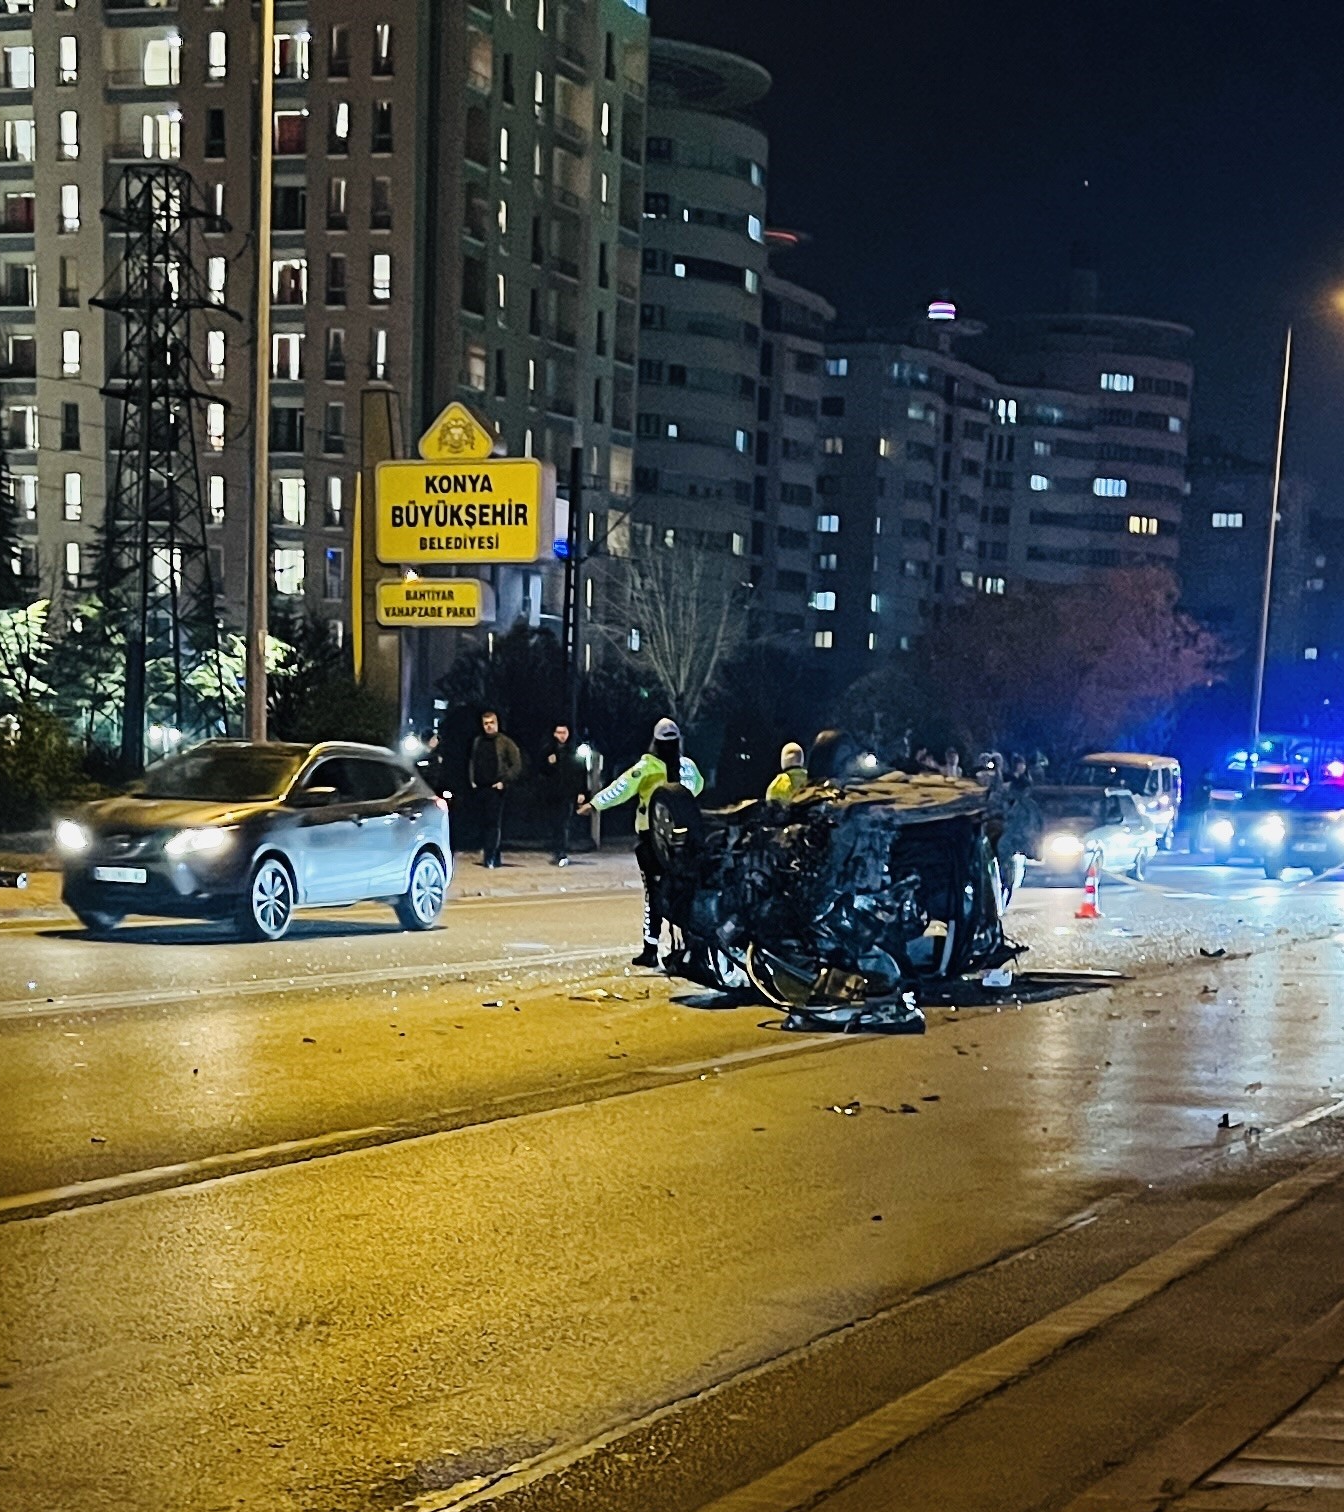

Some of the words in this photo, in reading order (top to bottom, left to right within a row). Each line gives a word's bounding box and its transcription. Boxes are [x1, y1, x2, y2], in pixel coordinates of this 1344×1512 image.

[425, 474, 493, 494] KONYA
[391, 498, 528, 528] BÜYÜKŞEHİR
[419, 533, 500, 550] BELEDİYESİ
